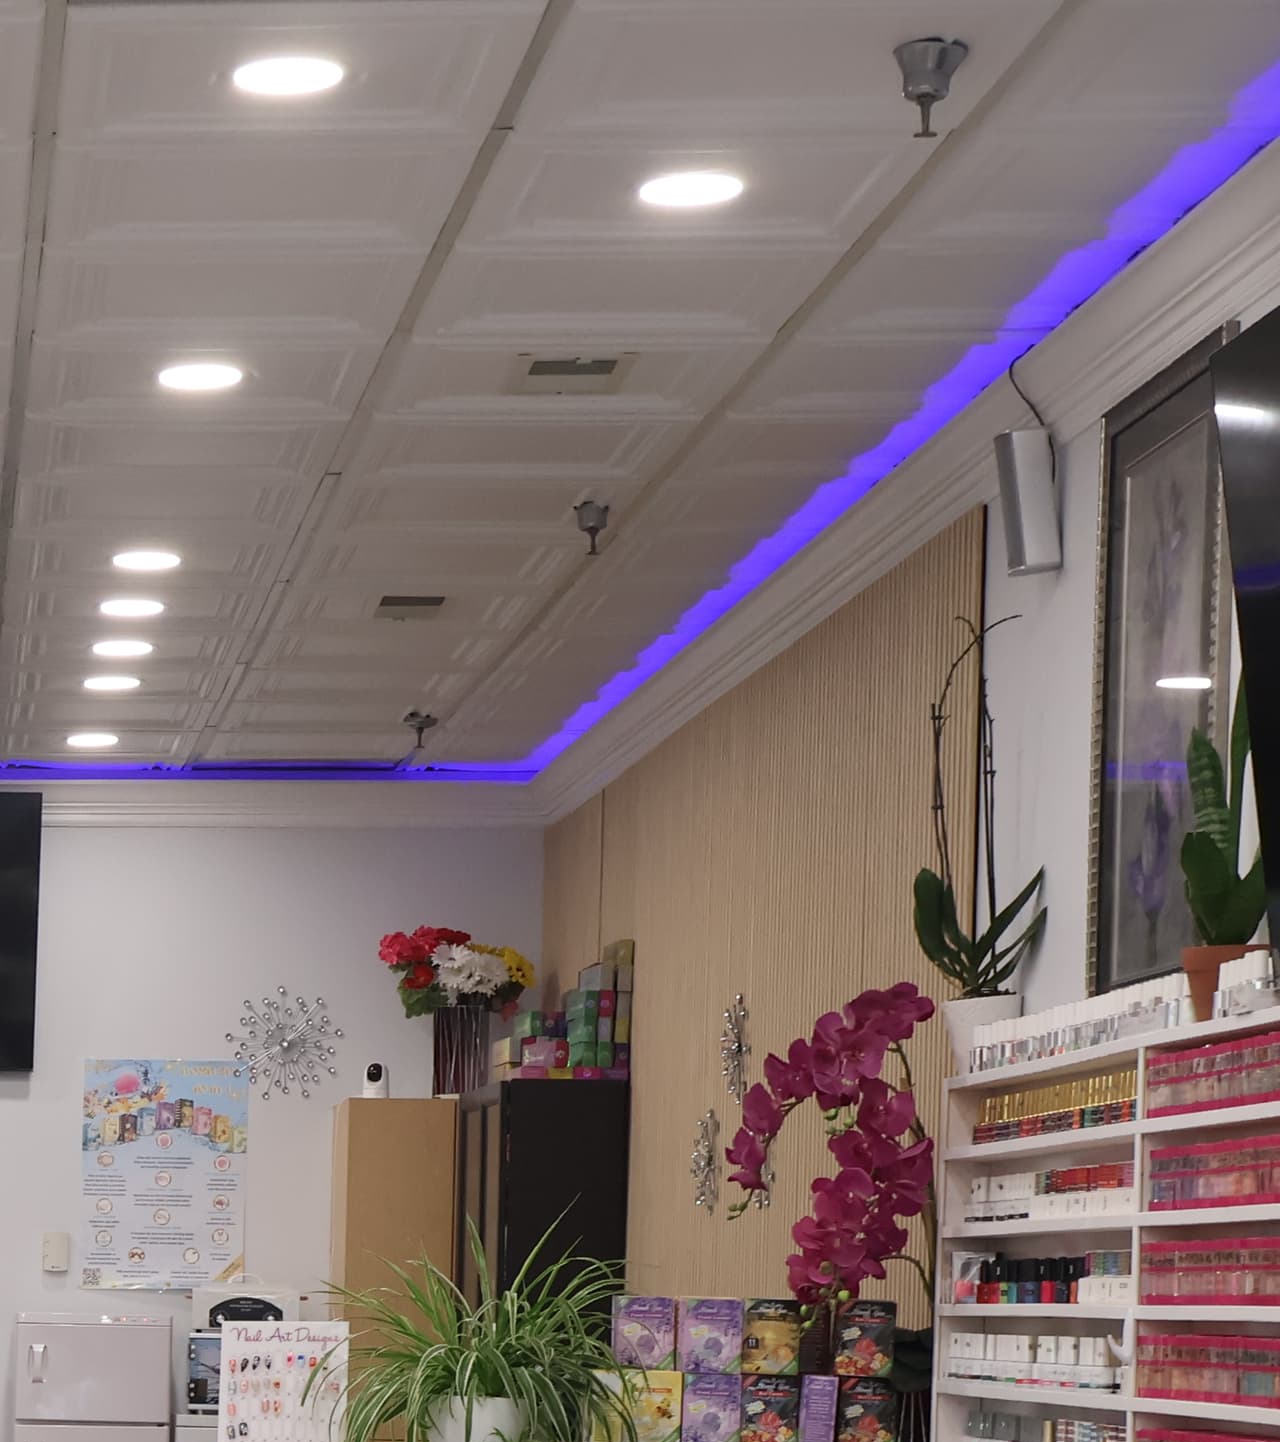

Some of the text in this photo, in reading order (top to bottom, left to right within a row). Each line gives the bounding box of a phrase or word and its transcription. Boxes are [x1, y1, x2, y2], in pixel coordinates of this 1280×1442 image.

[230, 1327, 341, 1351] Nail Art Designs
